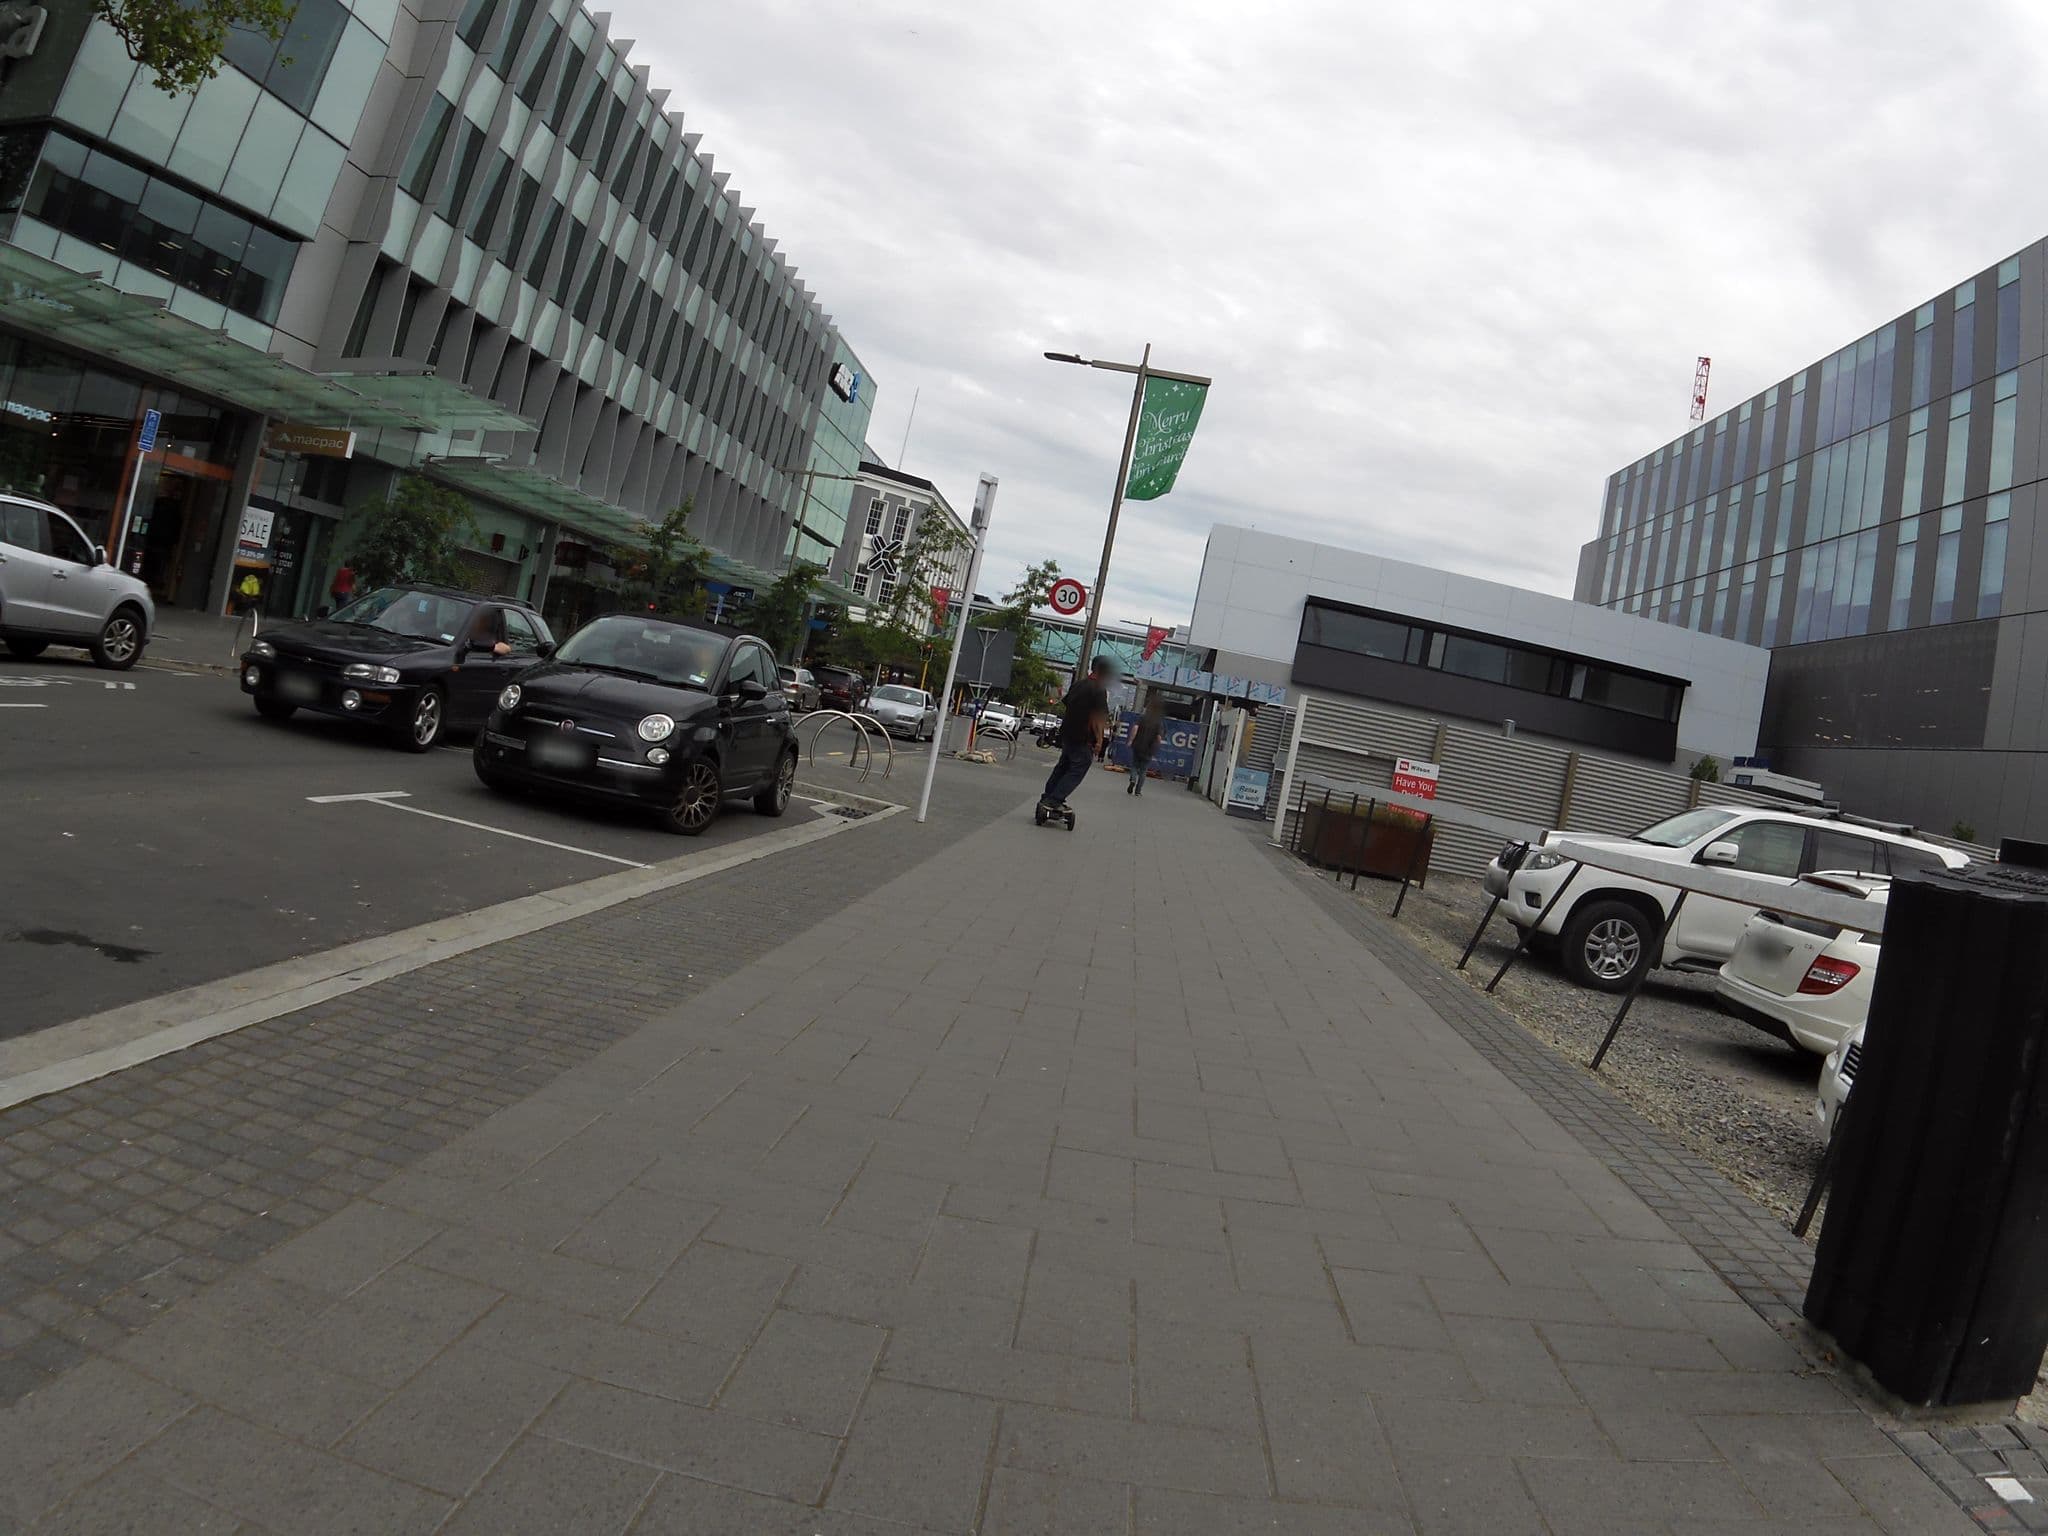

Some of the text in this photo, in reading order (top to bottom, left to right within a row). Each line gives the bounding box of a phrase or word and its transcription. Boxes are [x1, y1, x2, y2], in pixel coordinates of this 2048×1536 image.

[1142, 408, 1190, 435] Merry
[294, 435, 344, 449] macpac
[241, 519, 268, 540] SALE
[1058, 589, 1078, 605] 30
[1395, 776, 1433, 792] Have You
